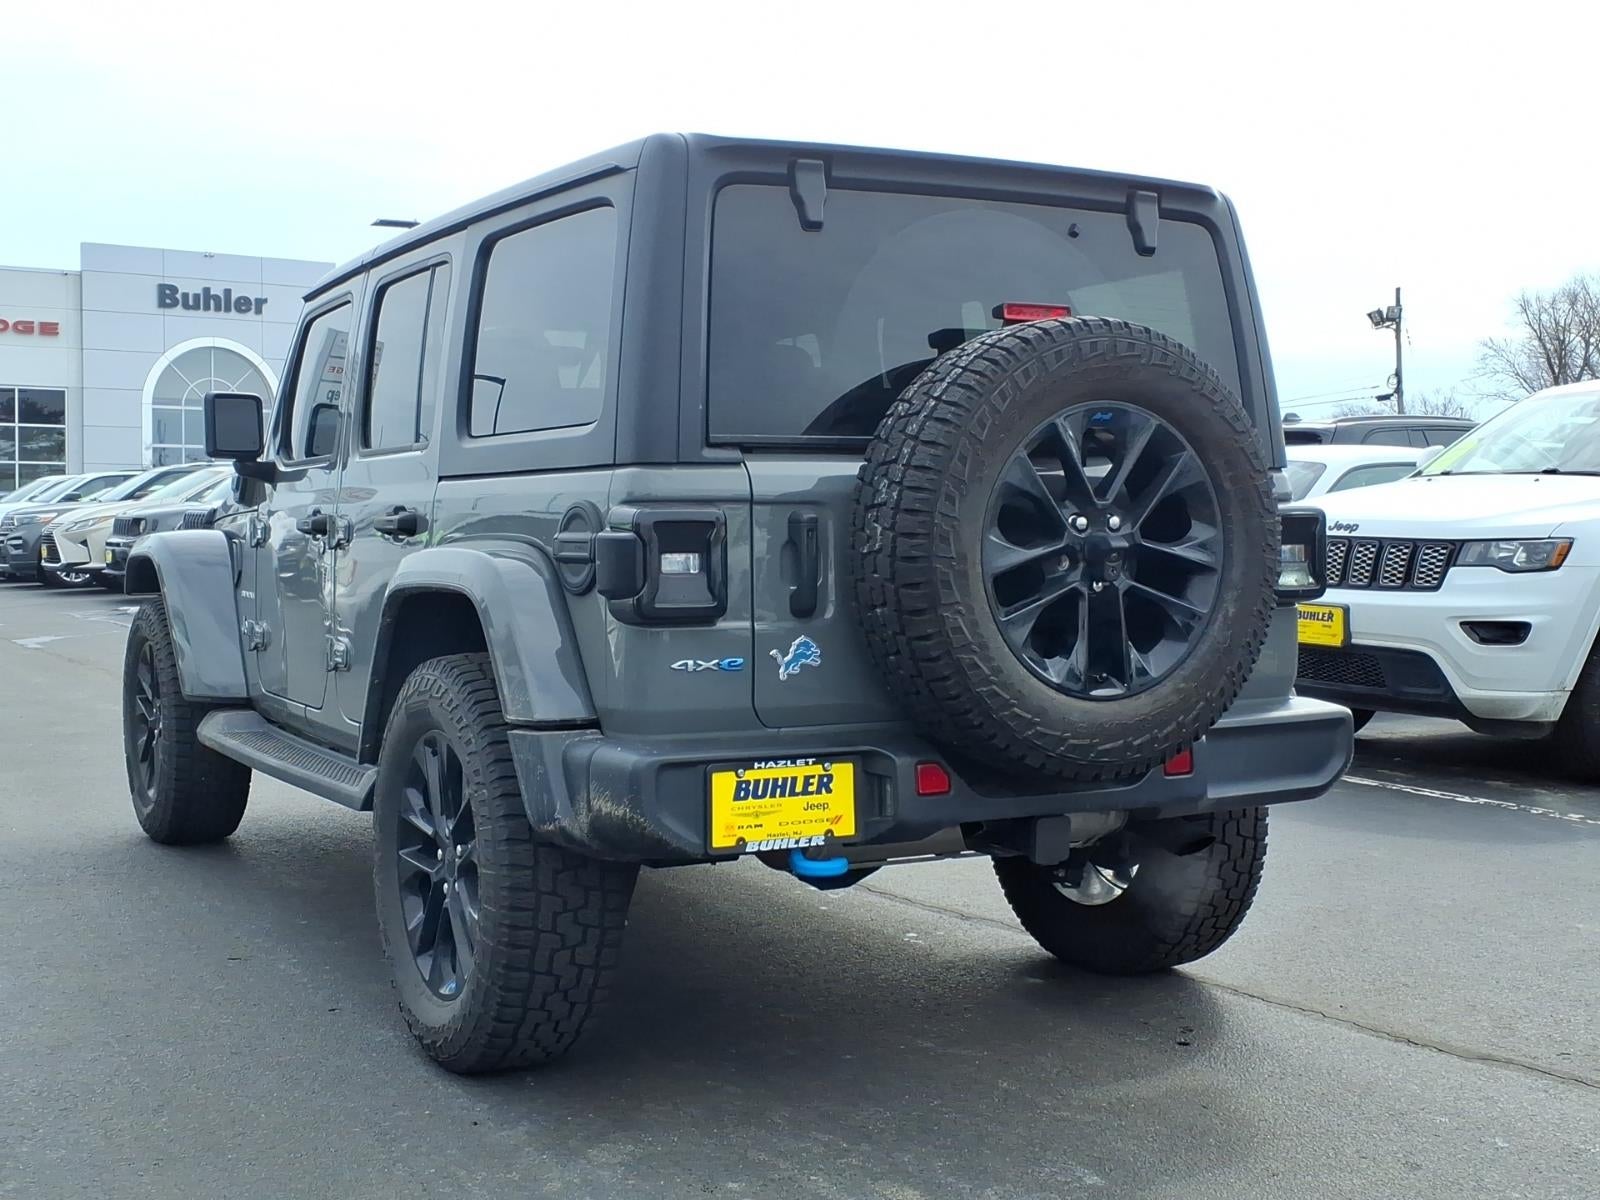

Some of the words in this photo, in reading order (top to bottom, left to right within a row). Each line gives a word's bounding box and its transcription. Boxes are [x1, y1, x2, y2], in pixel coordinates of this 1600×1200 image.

[157, 283, 268, 316] Buhler
[1328, 521, 1360, 533] Jeep
[754, 758, 816, 769] HAZLET
[732, 773, 834, 802] BUHLER
[730, 803, 783, 812] CHRYSLER
[803, 801, 830, 812] Jeep
[778, 817, 833, 827] DODGE
[745, 835, 825, 852] BUHLER
